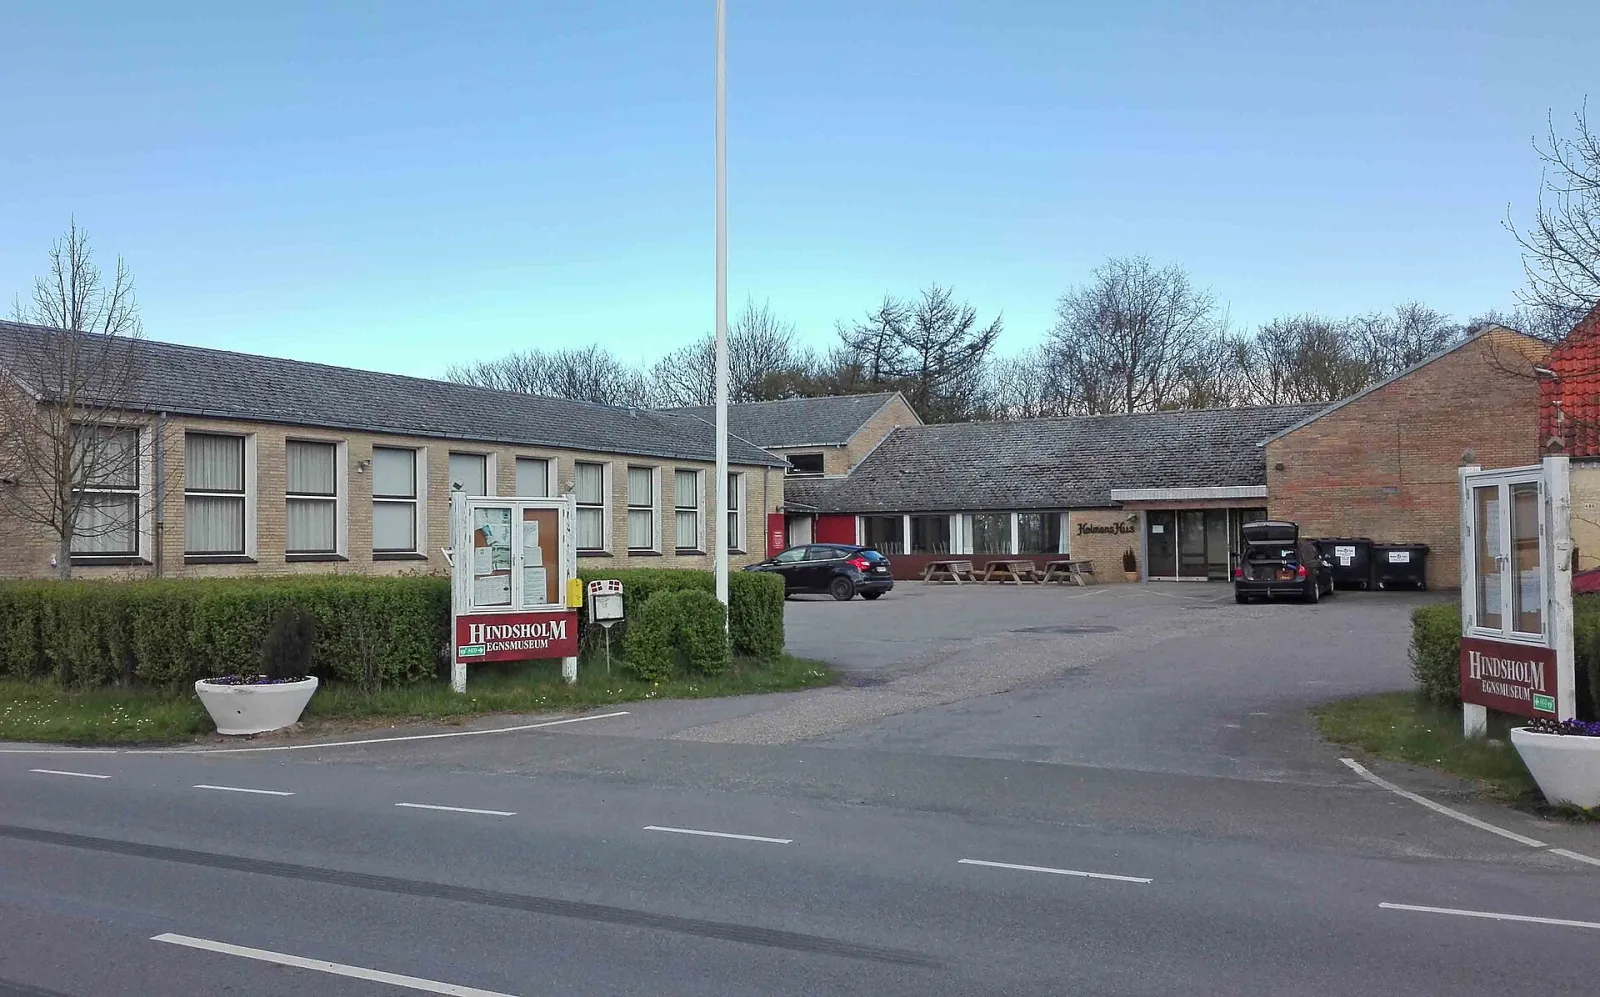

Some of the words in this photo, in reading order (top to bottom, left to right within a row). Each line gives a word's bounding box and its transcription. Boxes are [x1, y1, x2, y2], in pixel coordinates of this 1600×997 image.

[1113, 522, 1135, 535] Hus
[468, 620, 567, 644] HINDSHOLM
[486, 639, 548, 652] EGNSMUSEUM
[1468, 650, 1546, 692] HINDSHOLM
[1482, 679, 1531, 701] EGNSMUSEUM
